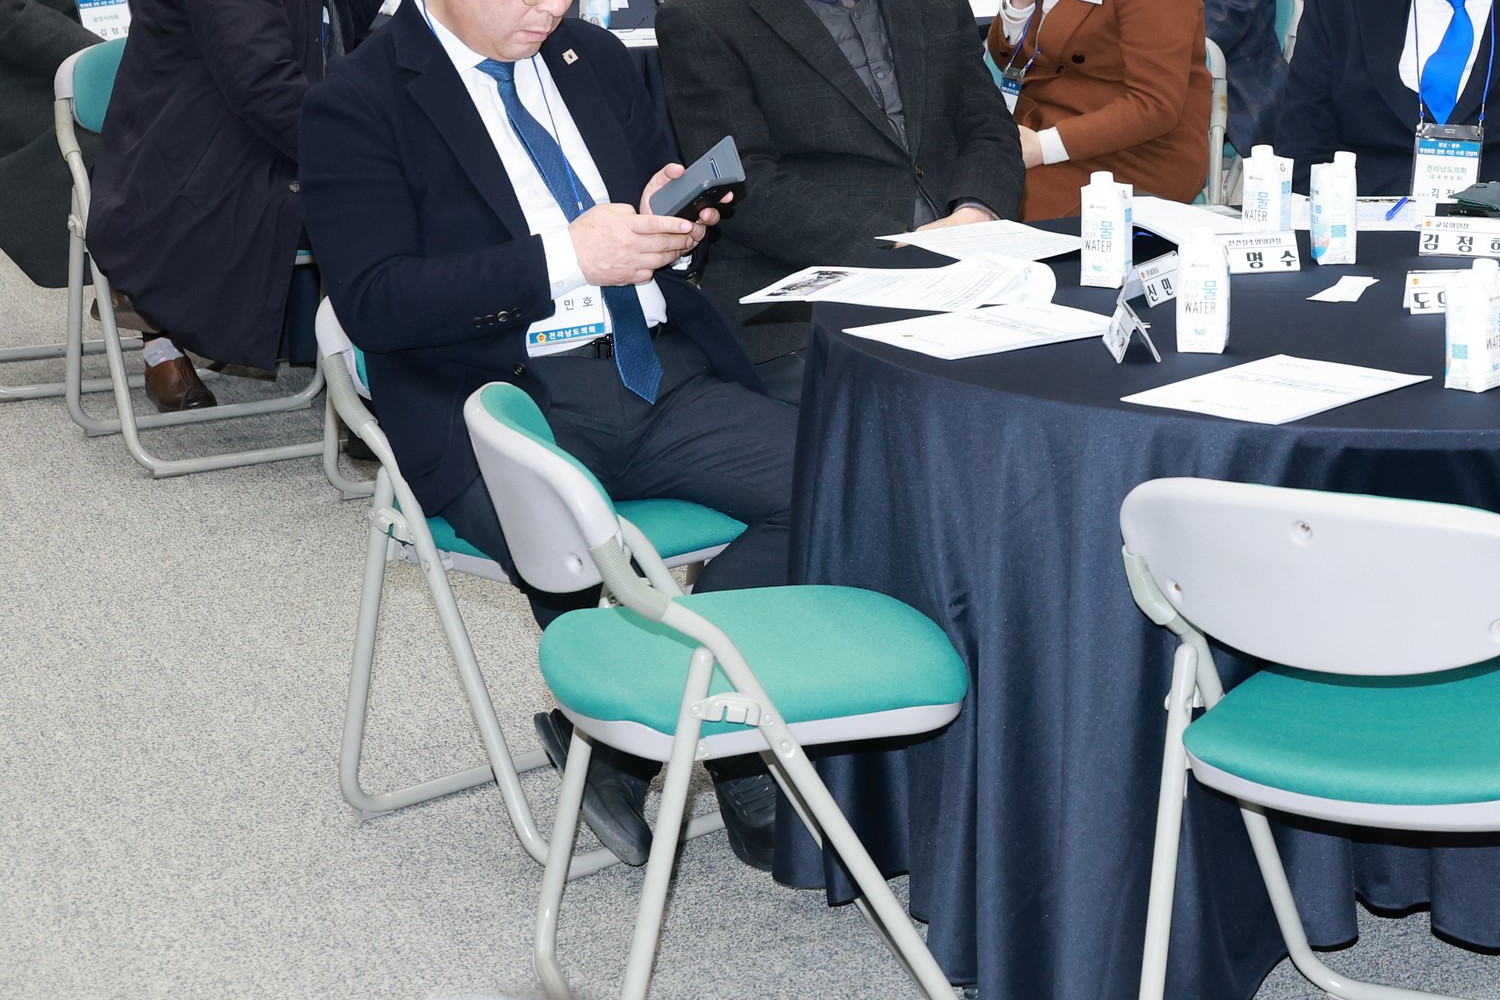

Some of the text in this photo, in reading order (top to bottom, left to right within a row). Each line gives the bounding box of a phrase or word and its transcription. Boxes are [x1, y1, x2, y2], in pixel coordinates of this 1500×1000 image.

[1244, 209, 1268, 222] WATER
[1084, 239, 1112, 253] WATER
[1184, 301, 1216, 315] WATER
[548, 325, 596, 340] 전라남도의회
